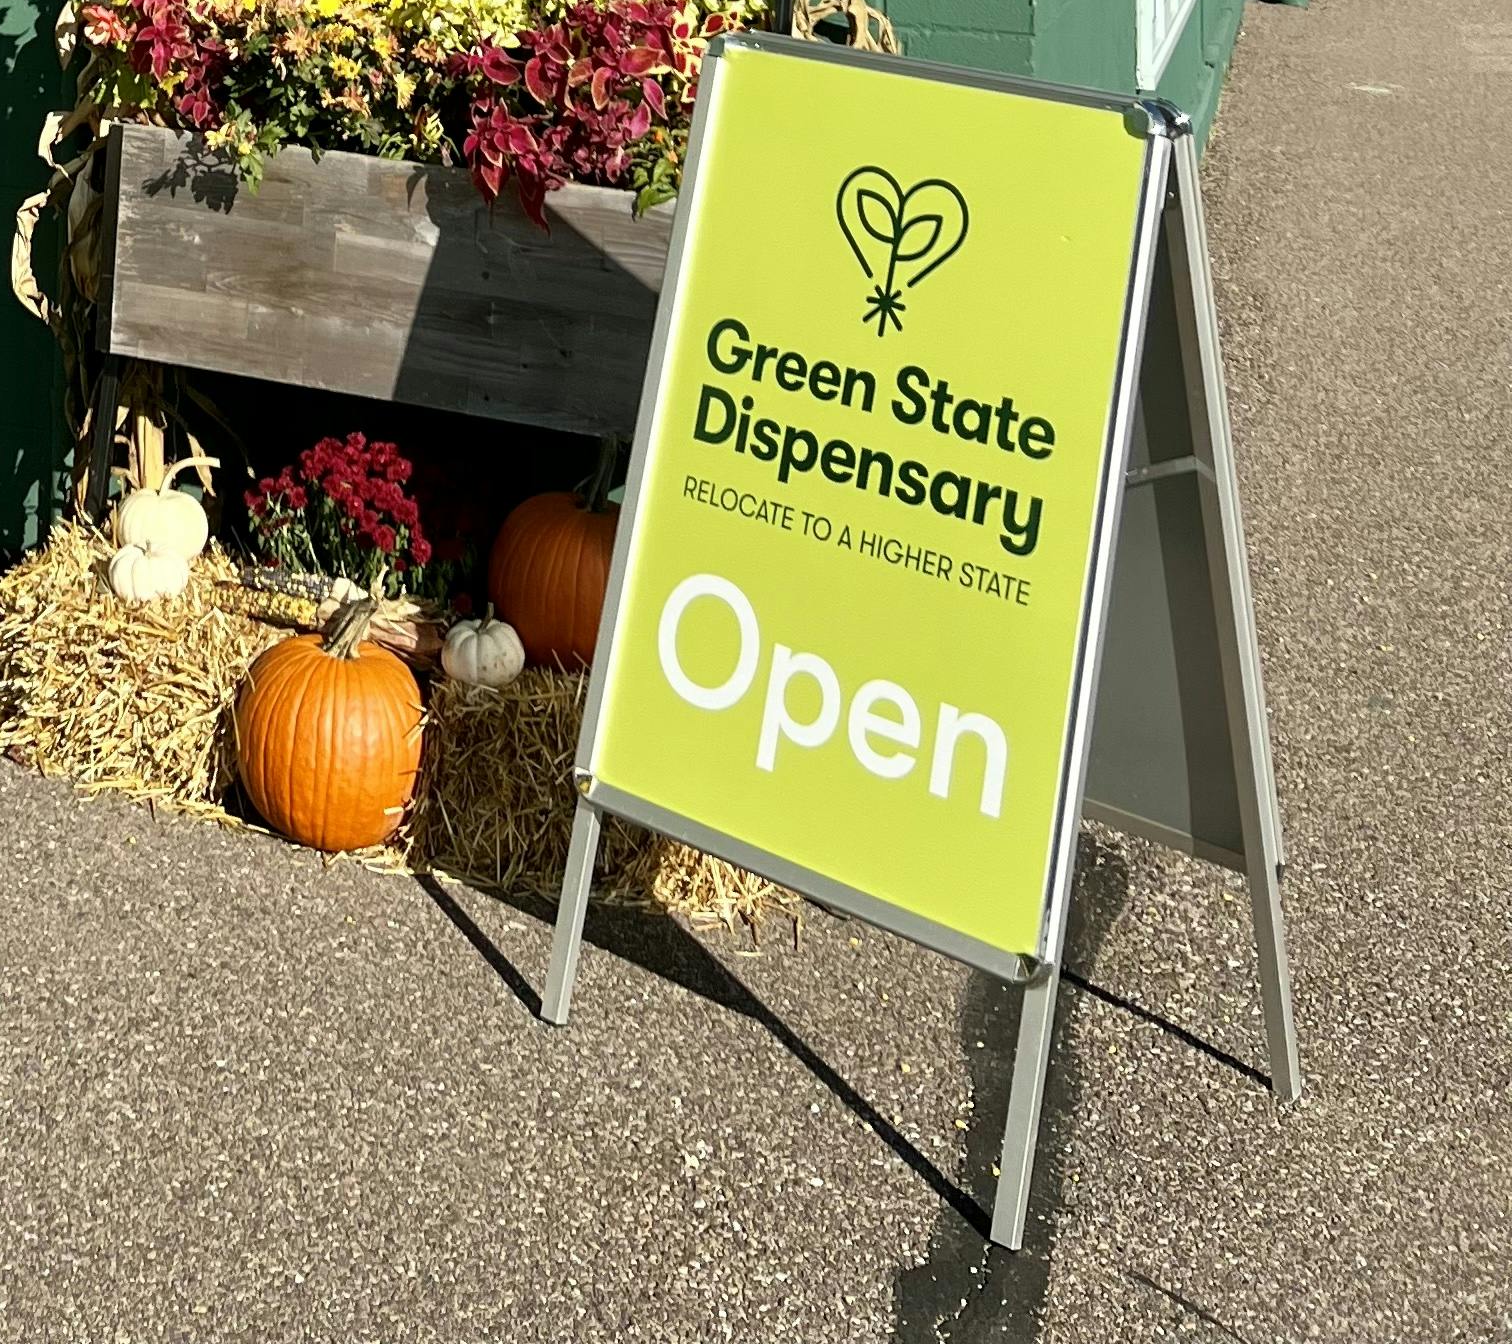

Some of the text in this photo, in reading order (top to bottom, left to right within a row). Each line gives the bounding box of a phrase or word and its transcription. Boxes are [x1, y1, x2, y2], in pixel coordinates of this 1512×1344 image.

[707, 318, 1055, 460] Green State
[683, 475, 1031, 606] RELOCATE TO A HIGHER STATE
[693, 384, 1043, 556] Dispensary
[657, 573, 1009, 819] Open
